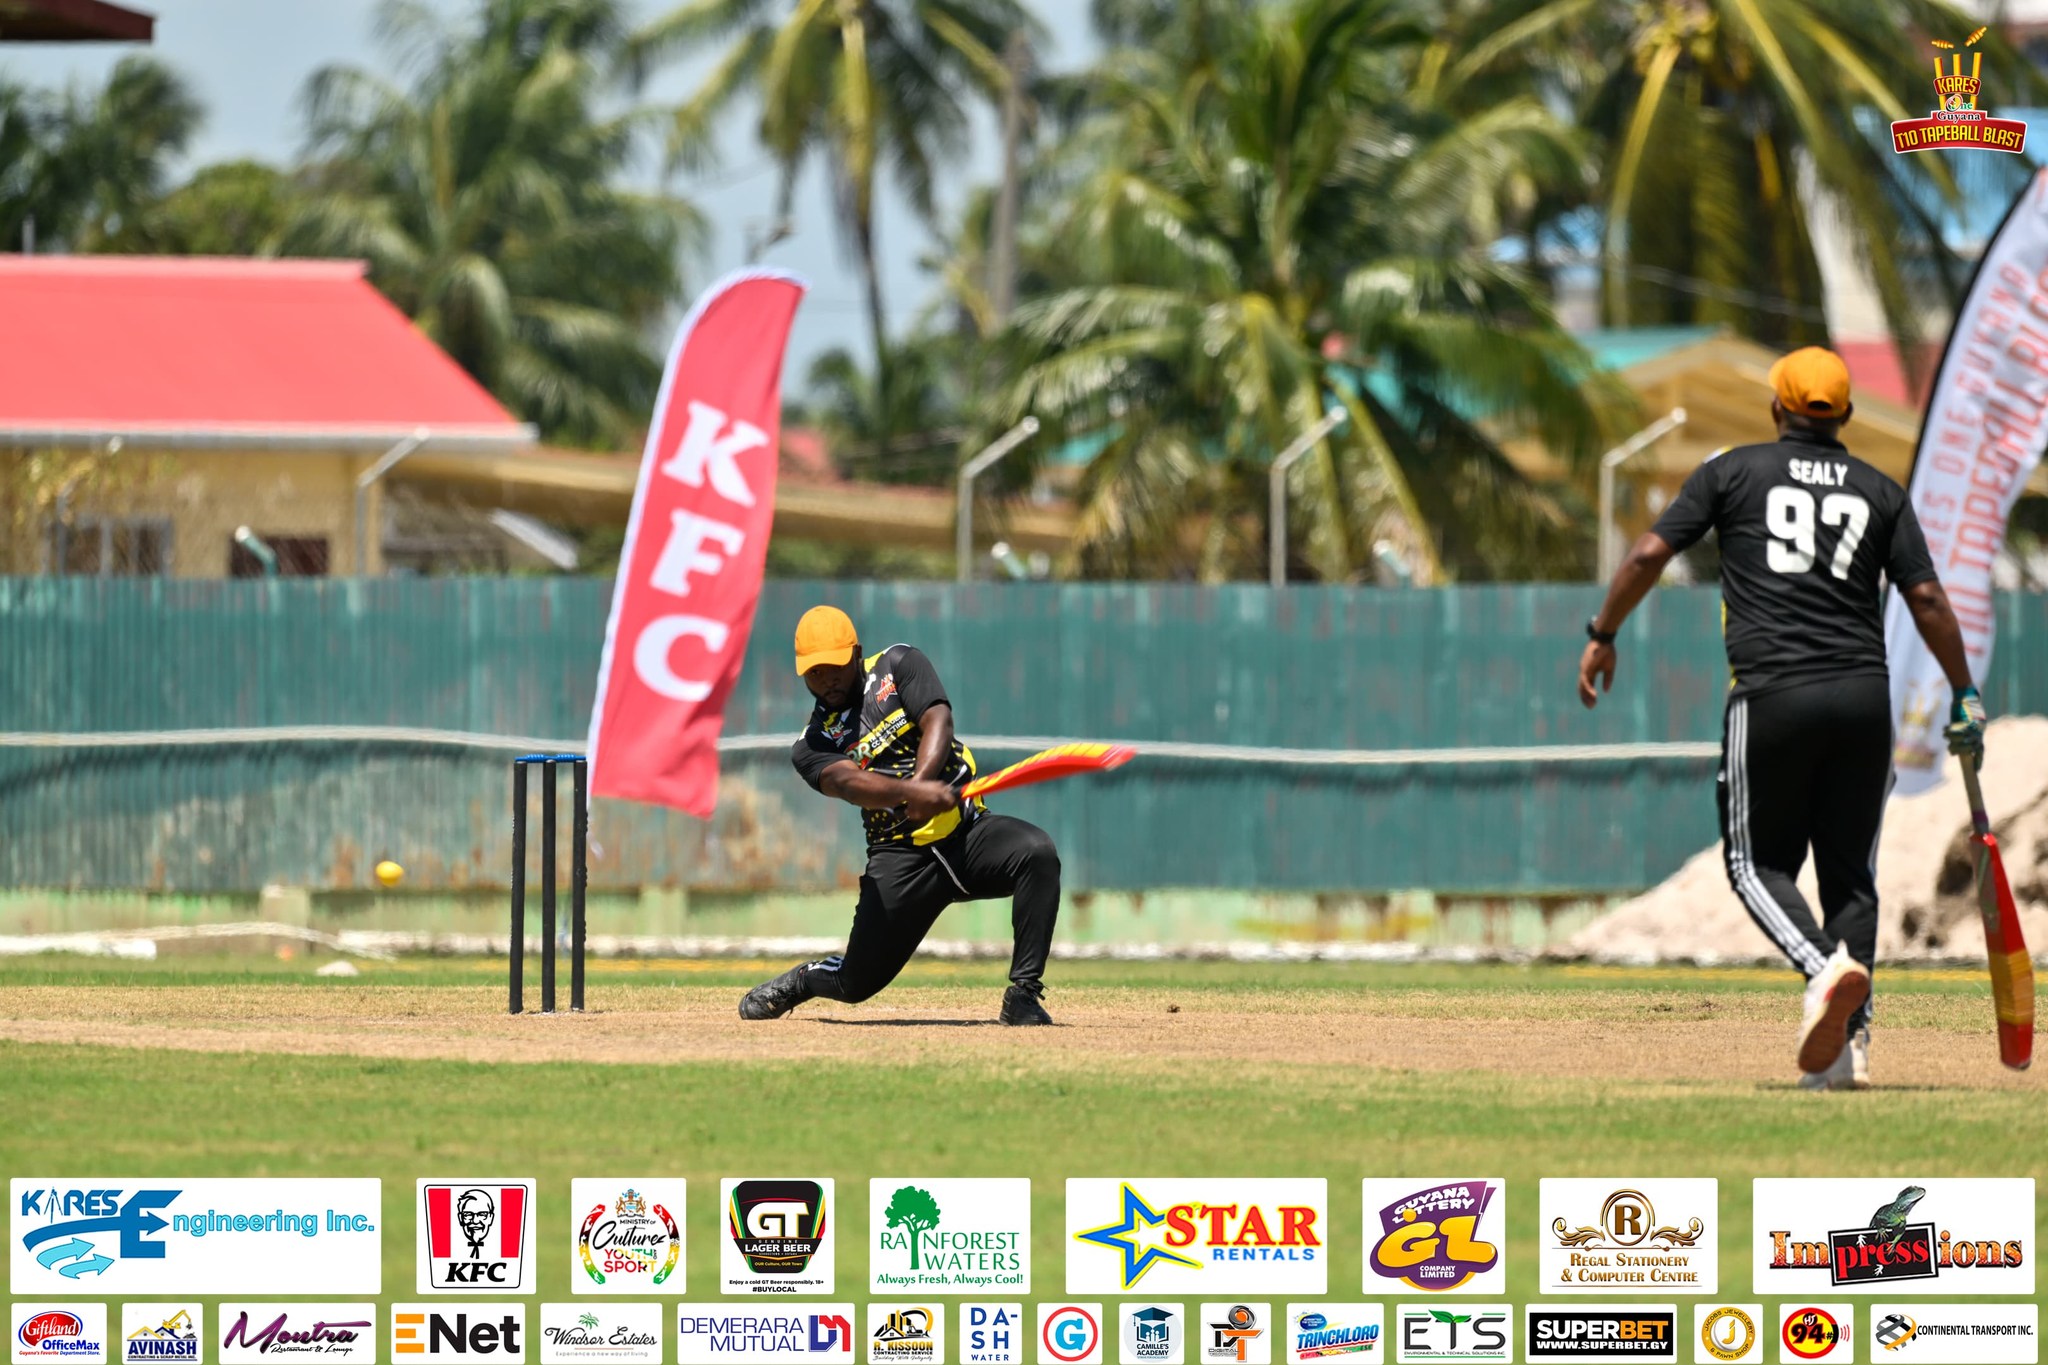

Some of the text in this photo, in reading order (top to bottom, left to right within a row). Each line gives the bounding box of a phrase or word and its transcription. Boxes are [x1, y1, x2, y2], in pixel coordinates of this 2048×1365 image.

[1789, 457, 1848, 486] SEALY
[633, 400, 769, 701] KFC
[1766, 485, 1870, 580] 97
